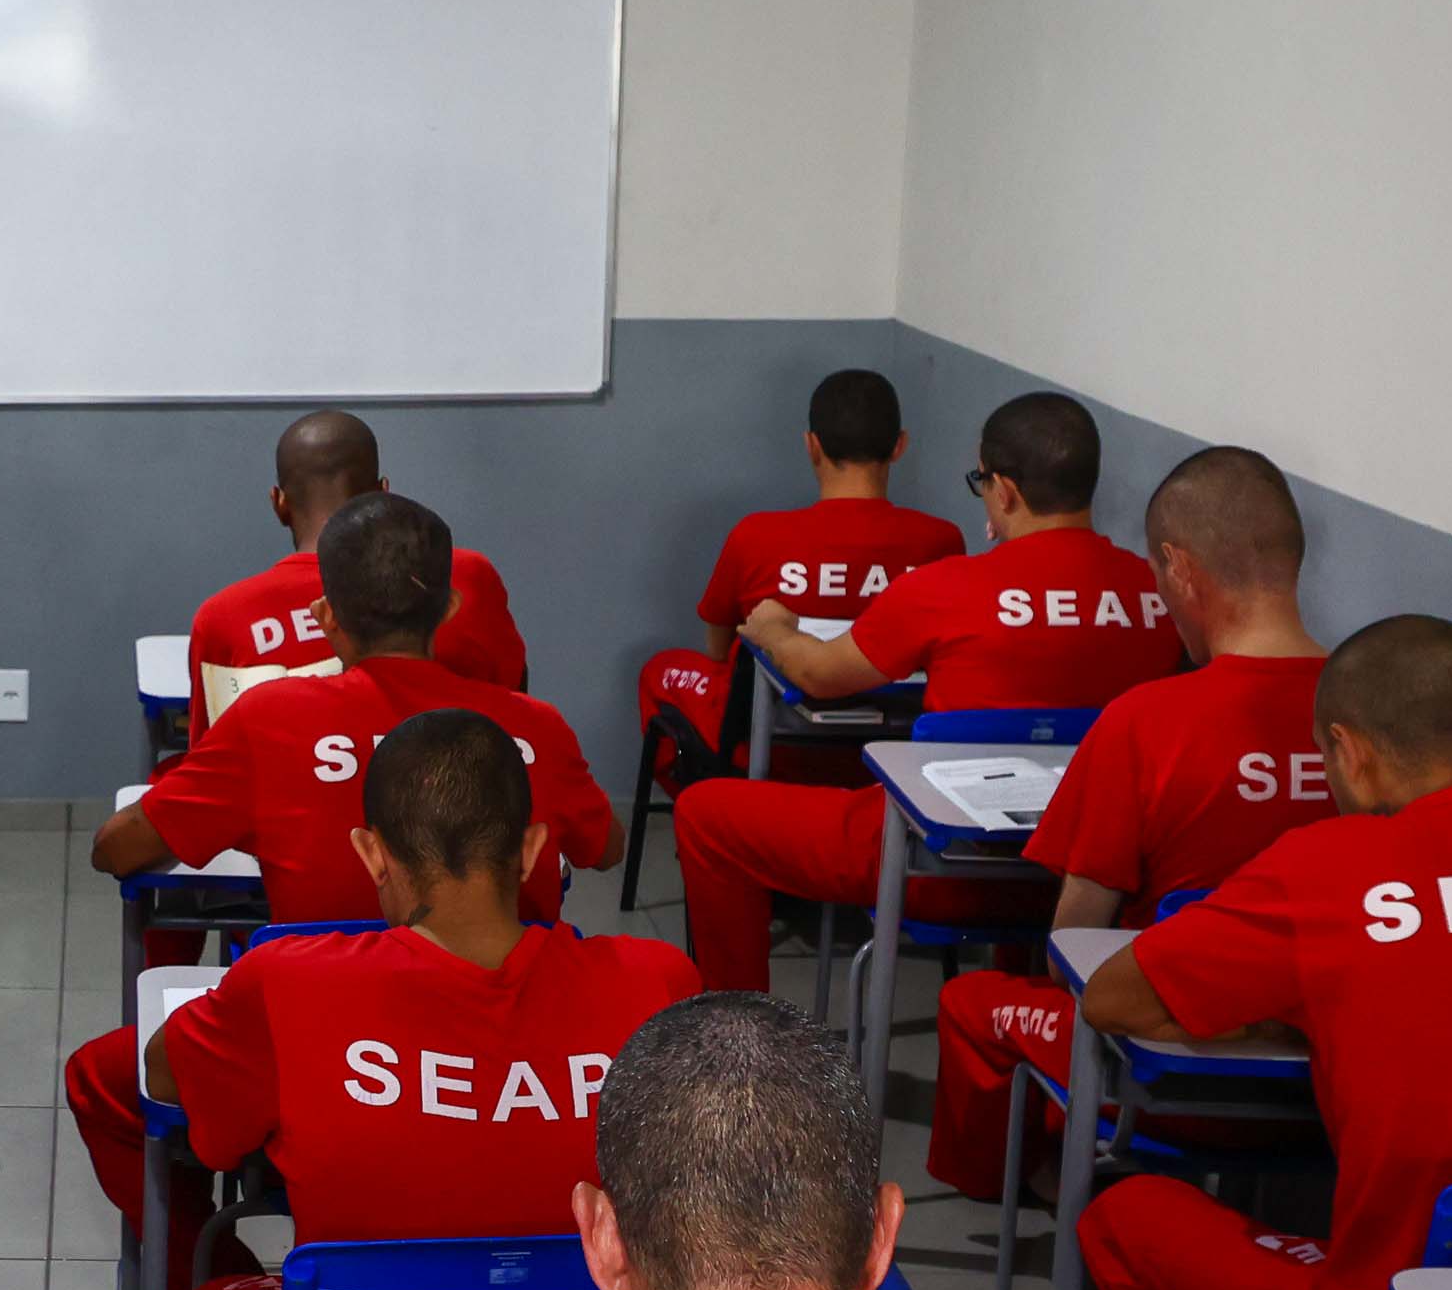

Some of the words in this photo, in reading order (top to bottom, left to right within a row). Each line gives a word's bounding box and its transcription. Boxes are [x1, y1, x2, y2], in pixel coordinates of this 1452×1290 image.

[778, 561, 916, 597] SEA
[998, 589, 1168, 628] SEAP
[1237, 752, 1329, 802] SE
[344, 1039, 613, 1122] SEAP
